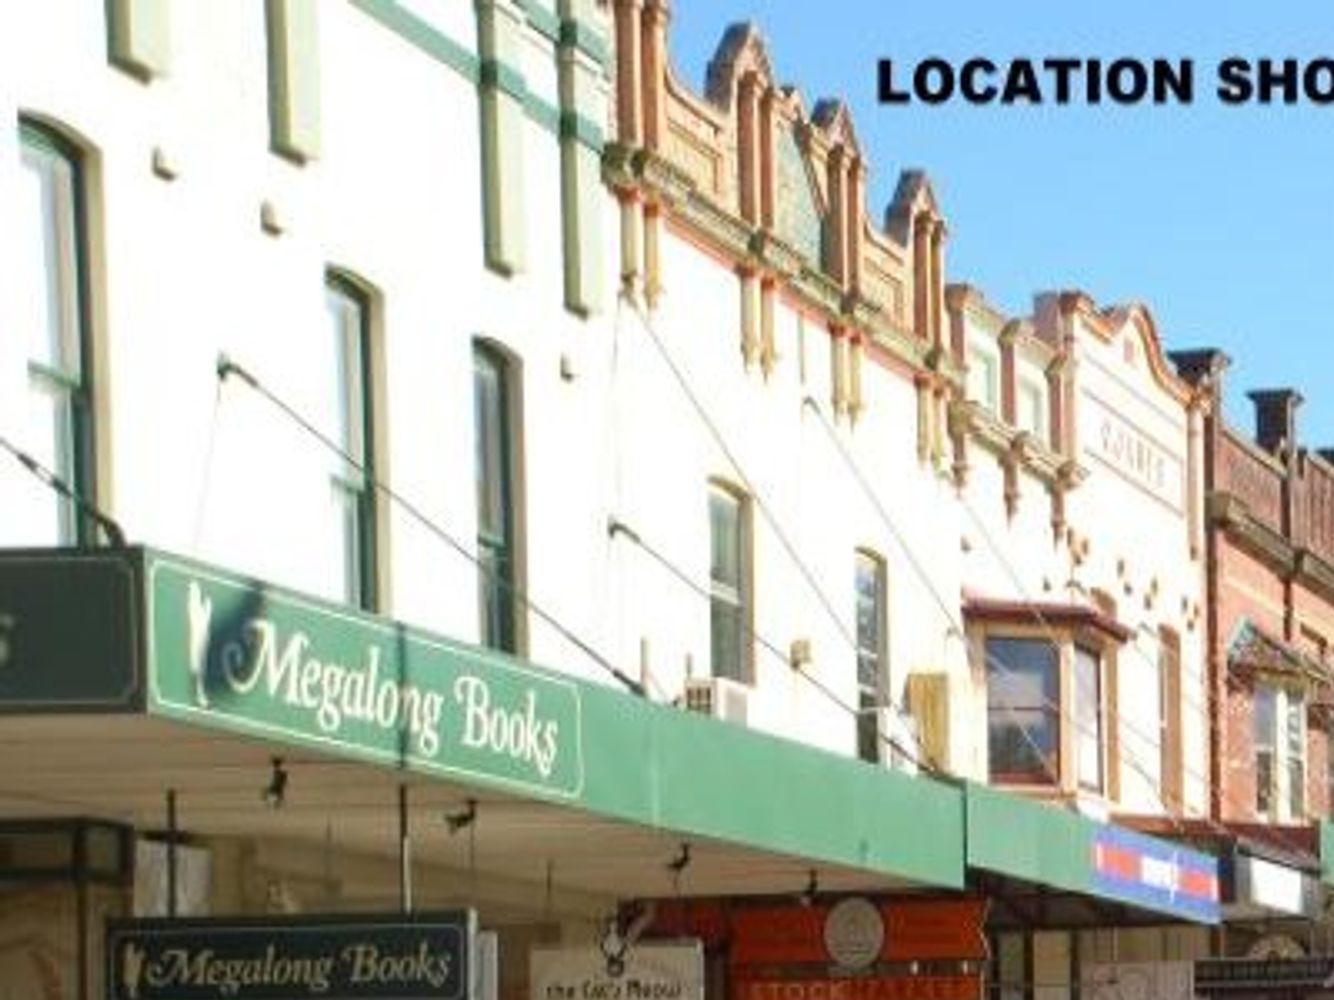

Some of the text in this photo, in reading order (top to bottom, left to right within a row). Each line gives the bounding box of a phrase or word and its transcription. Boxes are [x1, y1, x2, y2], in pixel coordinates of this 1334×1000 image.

[223, 619, 559, 779] Megalong Books
[146, 940, 452, 996] Megalong Books
